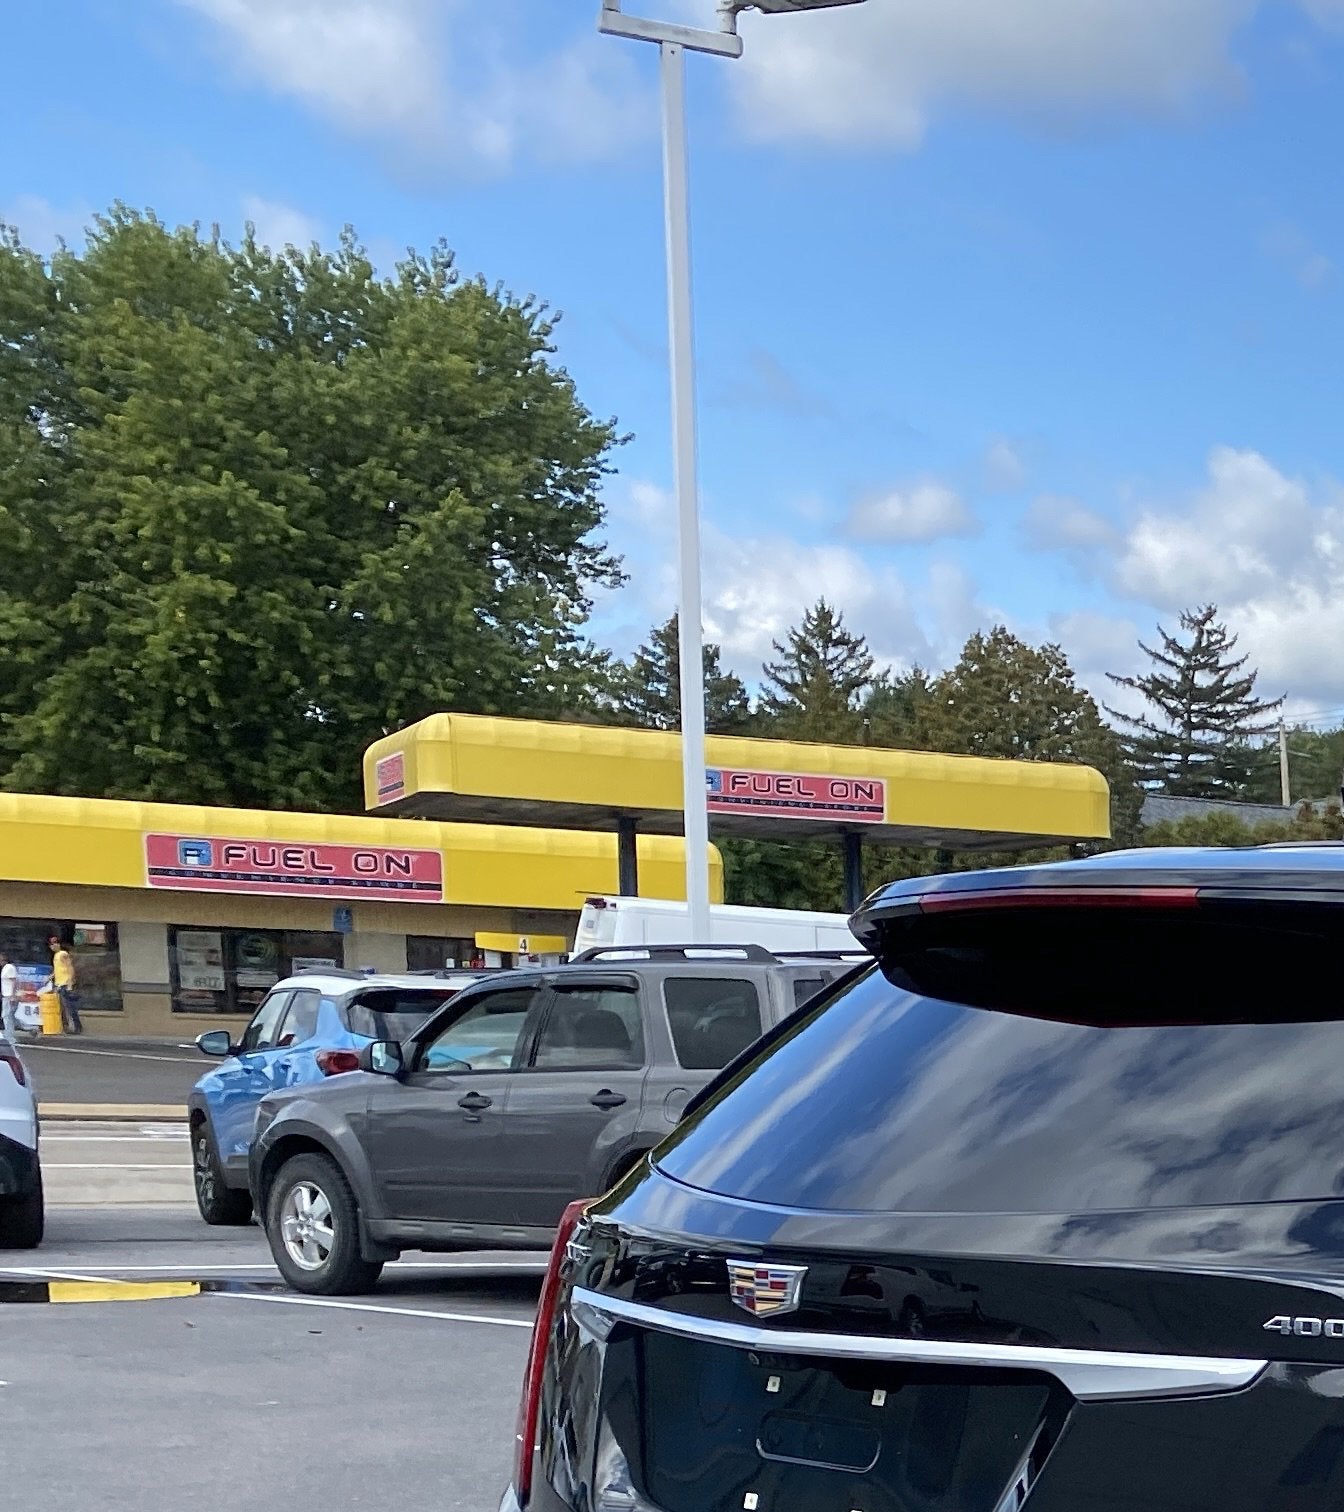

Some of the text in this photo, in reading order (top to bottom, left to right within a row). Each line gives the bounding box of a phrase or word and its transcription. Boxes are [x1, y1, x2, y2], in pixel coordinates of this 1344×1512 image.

[730, 775, 874, 800] FUEL ON
[224, 845, 412, 875] FUEL ON
[519, 938, 527, 951] 4
